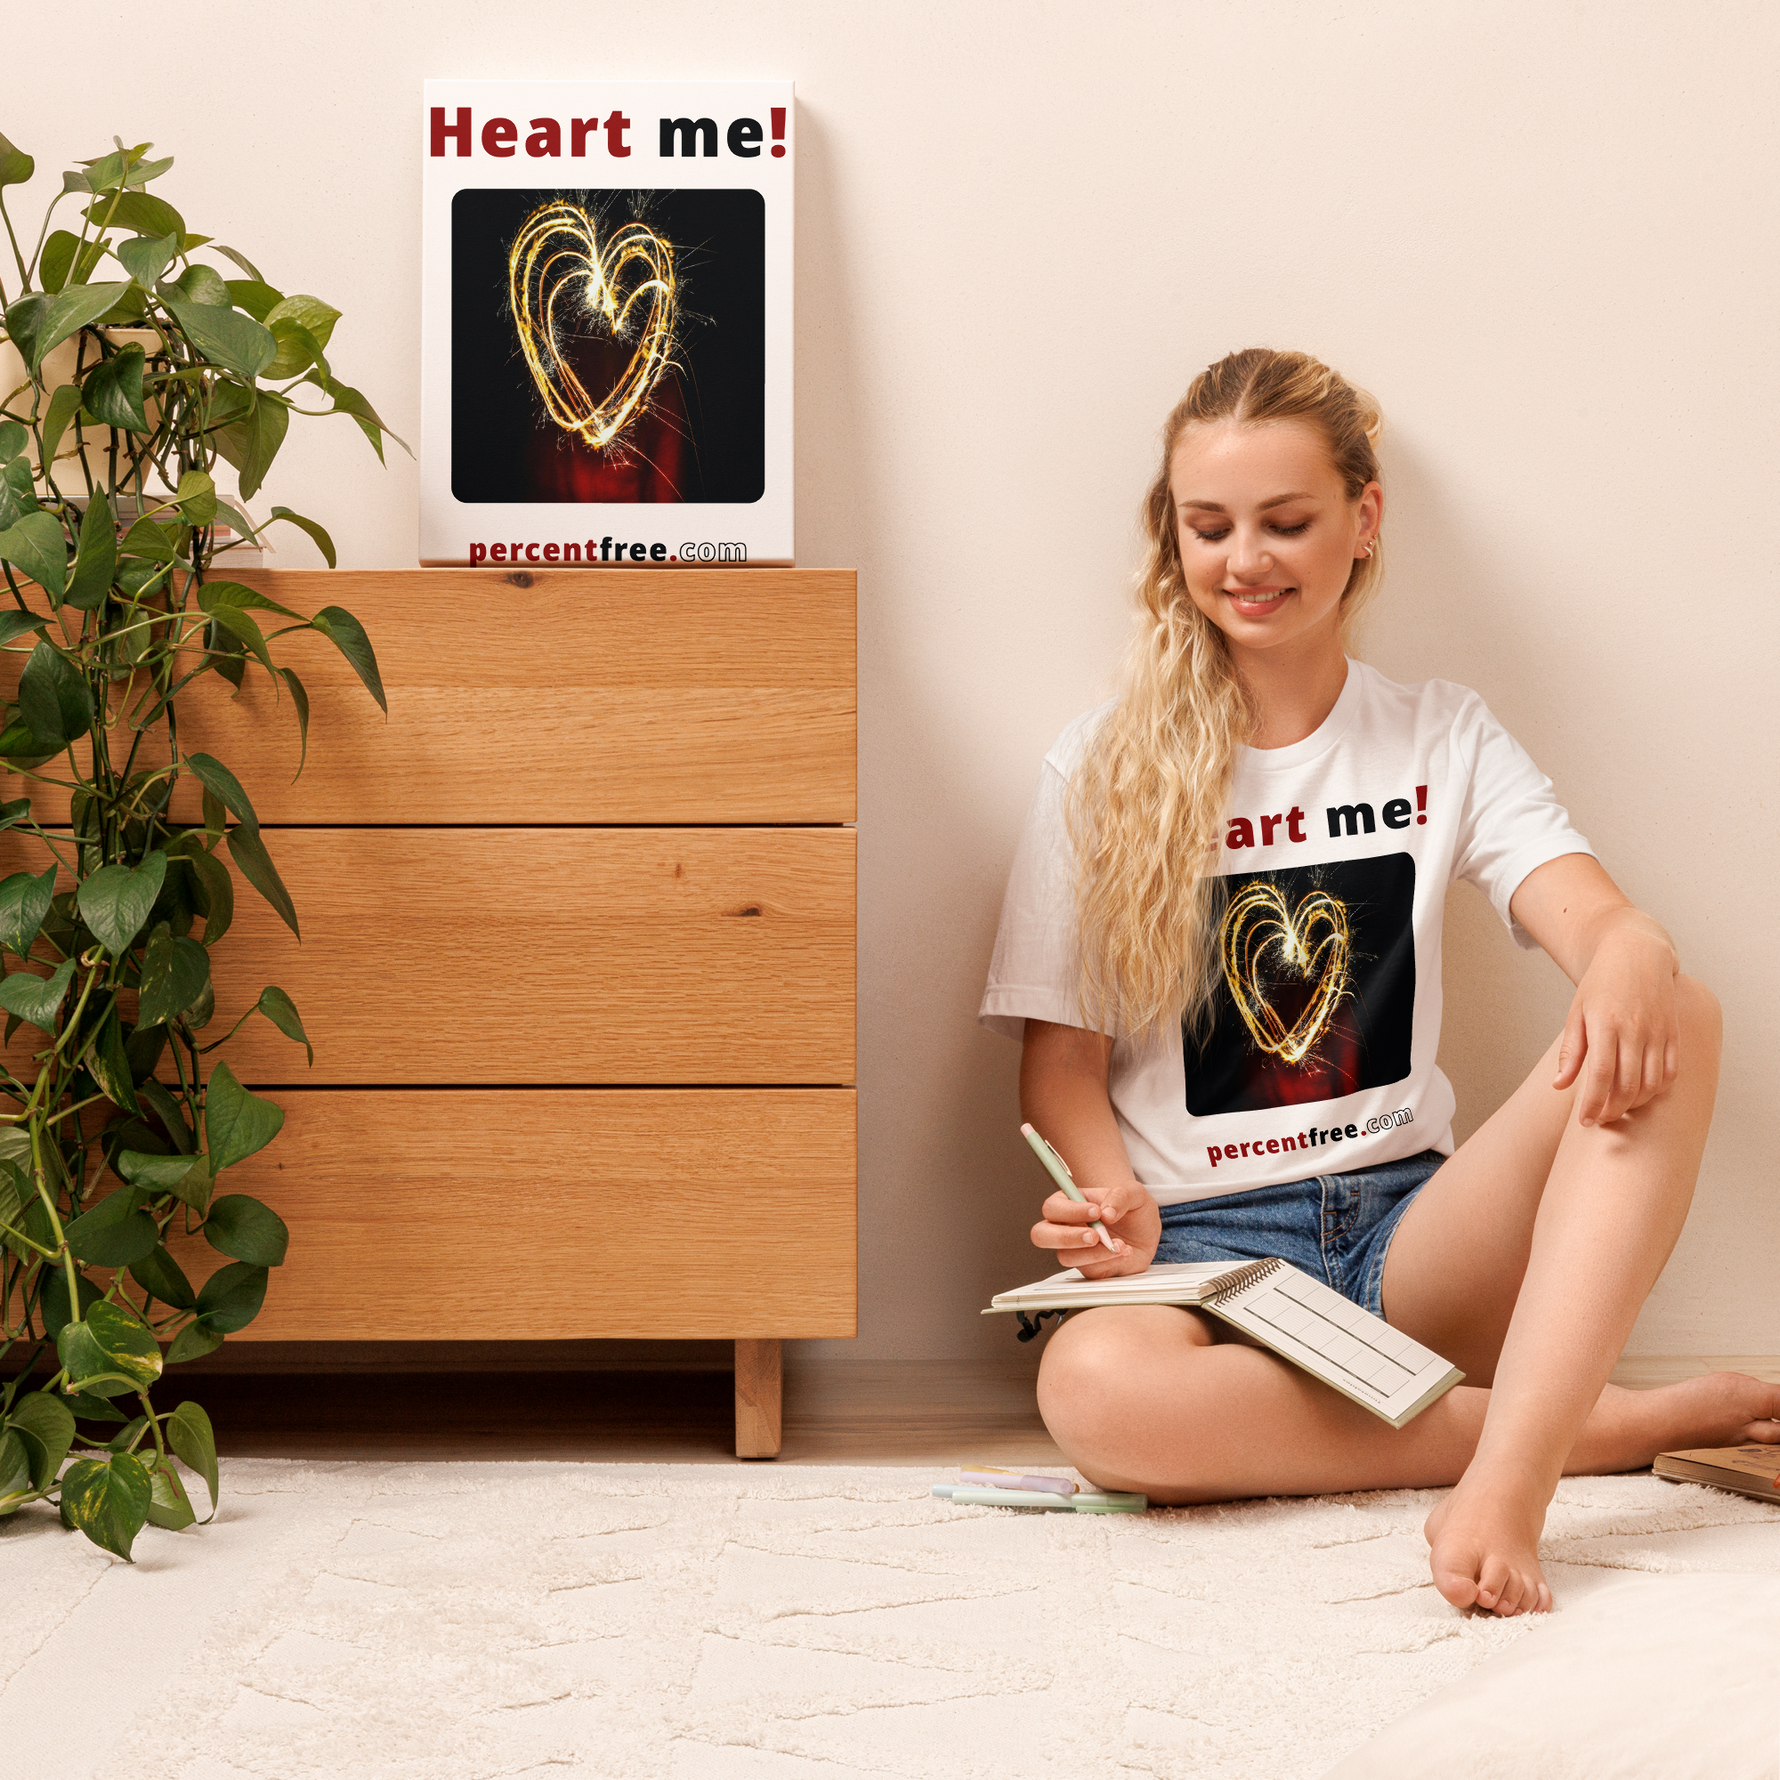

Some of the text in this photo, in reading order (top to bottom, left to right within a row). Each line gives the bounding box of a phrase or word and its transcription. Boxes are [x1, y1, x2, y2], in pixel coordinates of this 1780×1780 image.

[430, 106, 787, 158] Heart me!
[469, 536, 747, 568] percentfree.com
[1205, 784, 1428, 852] art me!
[1206, 1107, 1414, 1168] percentfree.com
